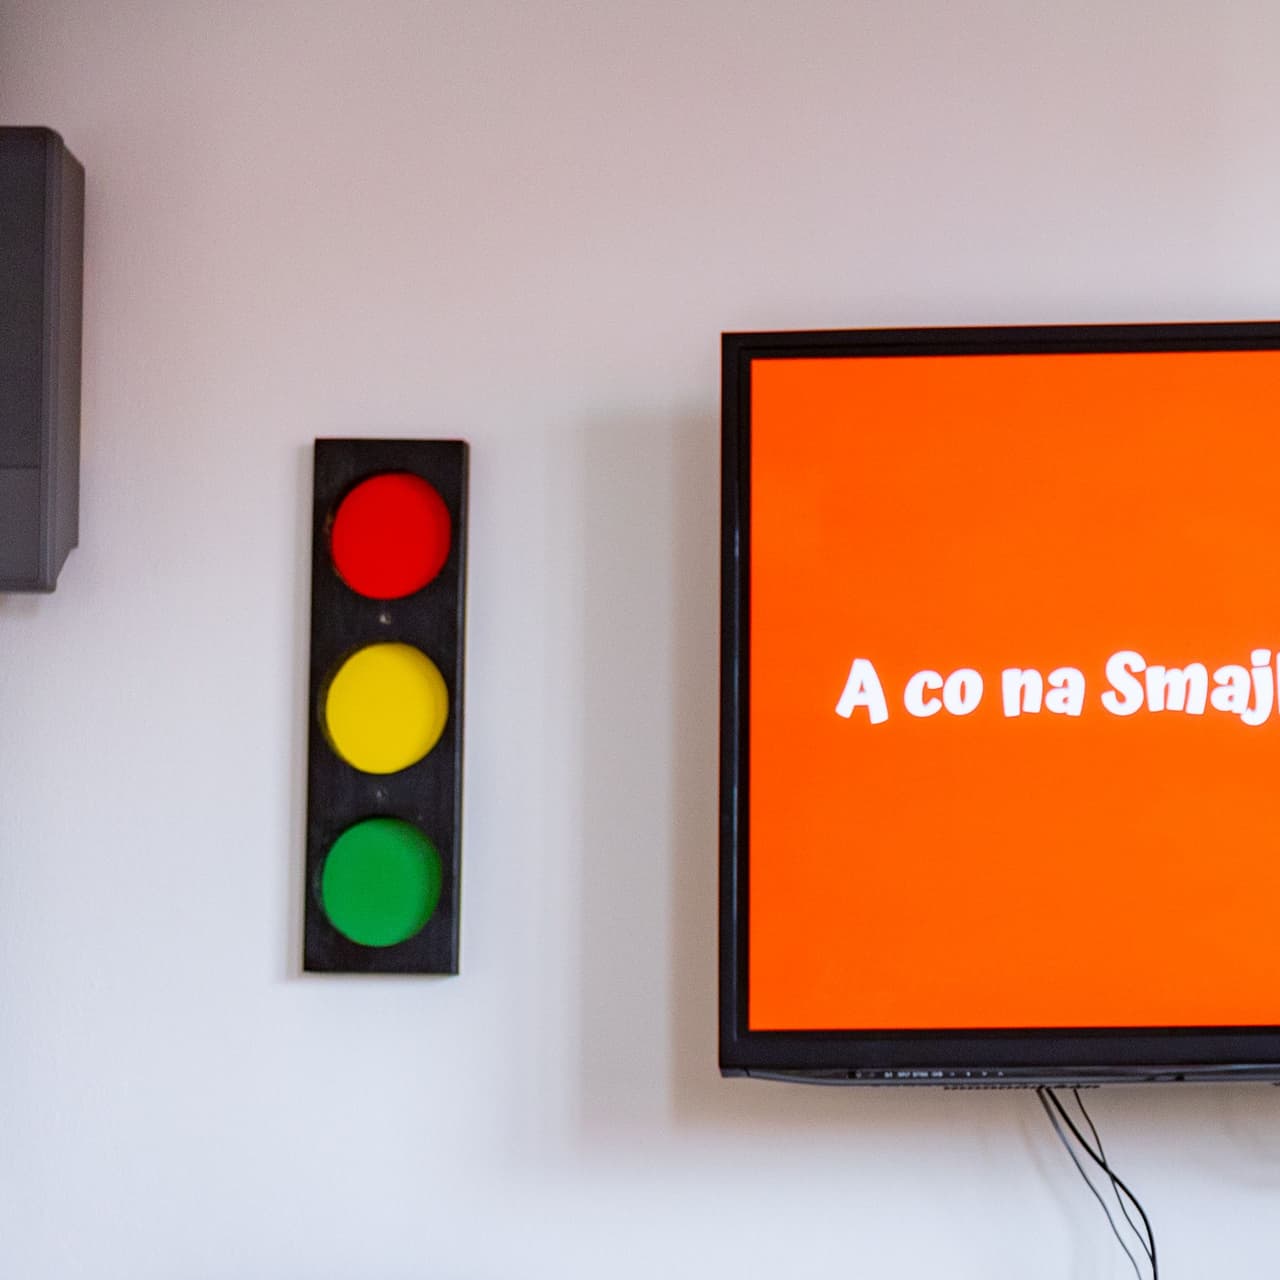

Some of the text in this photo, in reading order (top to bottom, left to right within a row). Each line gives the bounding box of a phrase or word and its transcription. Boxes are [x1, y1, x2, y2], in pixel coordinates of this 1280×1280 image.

[836, 659, 888, 724] A
[904, 669, 983, 717] co
[1002, 667, 1085, 717] na
